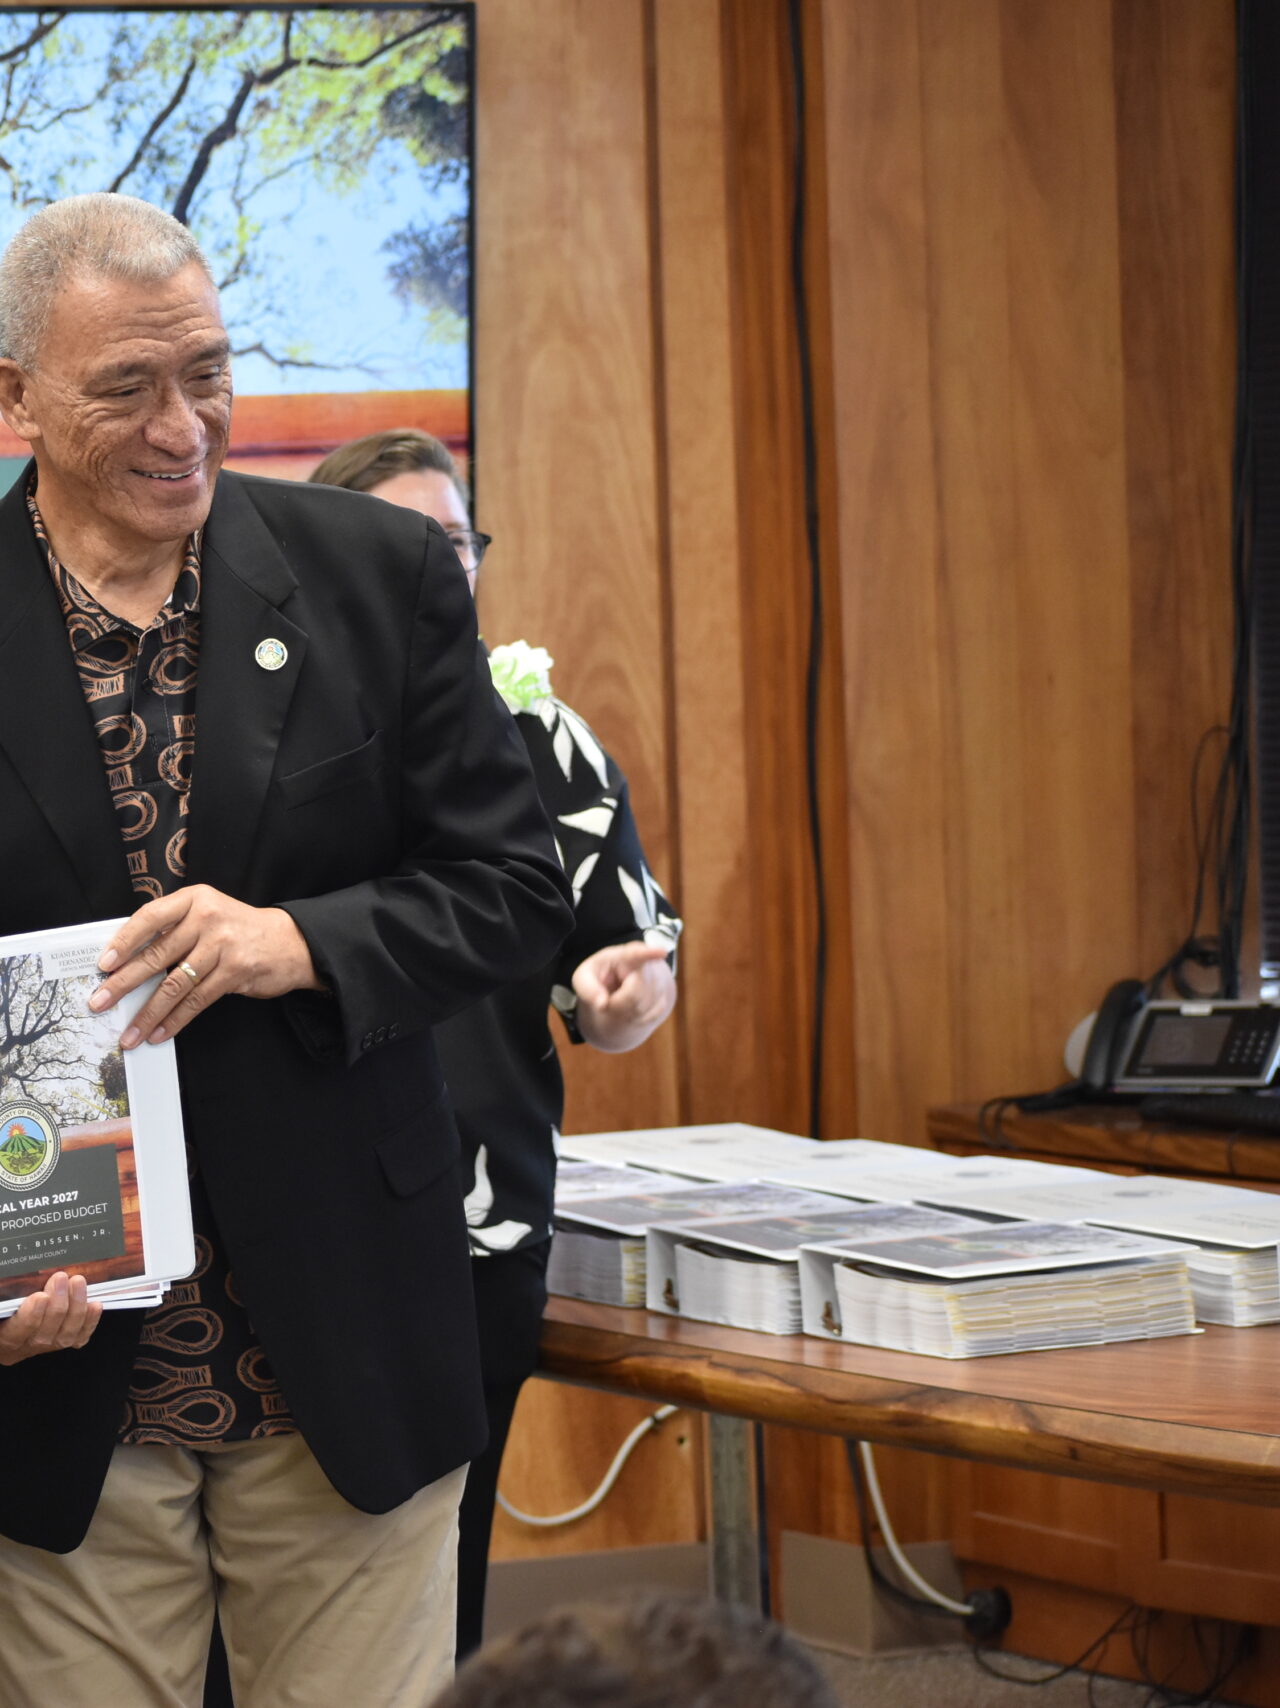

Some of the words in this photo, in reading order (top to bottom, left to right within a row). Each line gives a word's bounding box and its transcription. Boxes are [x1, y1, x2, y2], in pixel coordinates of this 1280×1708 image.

[26, 1110, 41, 1121] MAUI
[1, 1170, 19, 1183] STATE
[19, 1195, 50, 1210] YEAR
[52, 1190, 79, 1205] 2027
[1, 1211, 62, 1231] PROPOSED
[63, 1202, 109, 1220] BUDGET
[35, 1233, 85, 1248] BISSEN,
[92, 1228, 112, 1238] JR.
[19, 1255, 28, 1263] OF
[28, 1253, 44, 1261] MAUI
[44, 1249, 68, 1259] COUNTY
